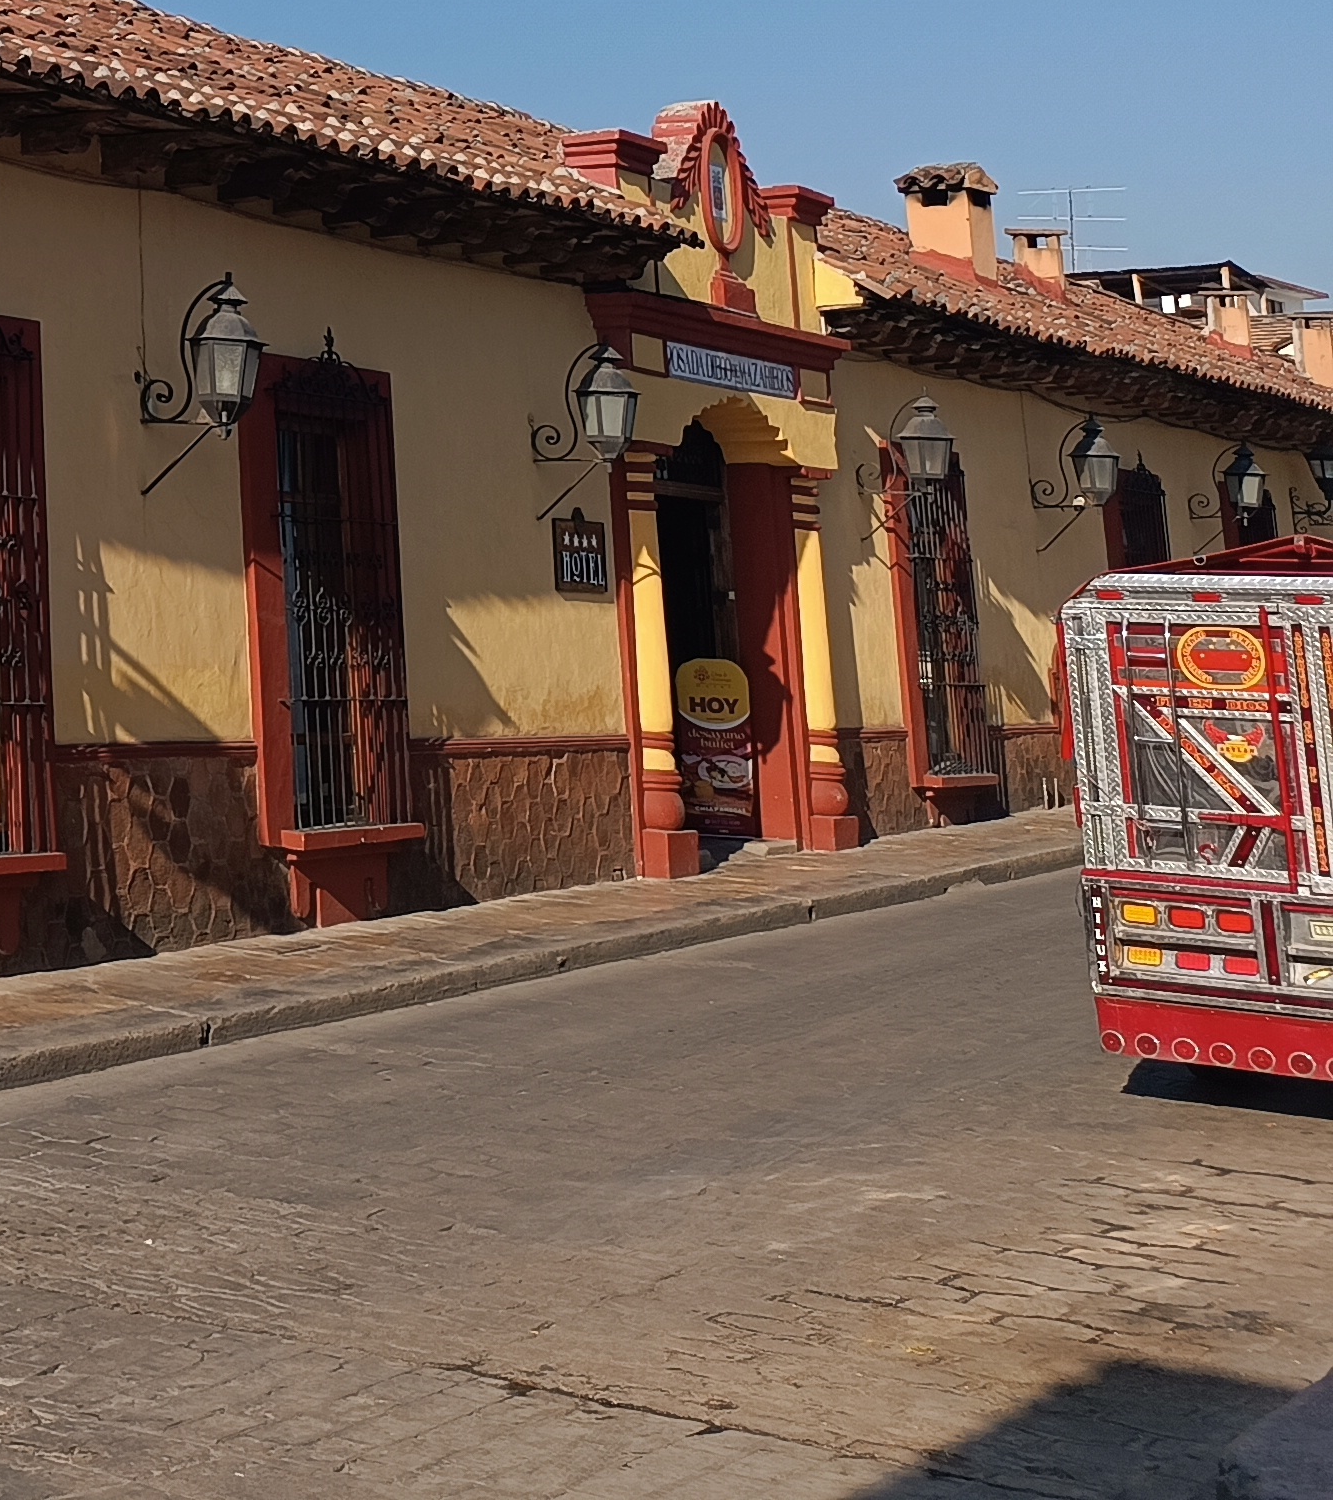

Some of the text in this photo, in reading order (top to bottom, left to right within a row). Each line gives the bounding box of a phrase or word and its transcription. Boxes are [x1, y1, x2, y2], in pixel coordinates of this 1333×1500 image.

[667, 345, 706, 378] POSADA
[562, 550, 606, 587] HOTEL
[688, 695, 740, 715] HOY
[1188, 698, 1213, 709] EN
[1226, 700, 1269, 711] DIOS
[687, 728, 746, 740] desayuno
[700, 738, 735, 749] buffet
[1091, 896, 1108, 972] HILUX
